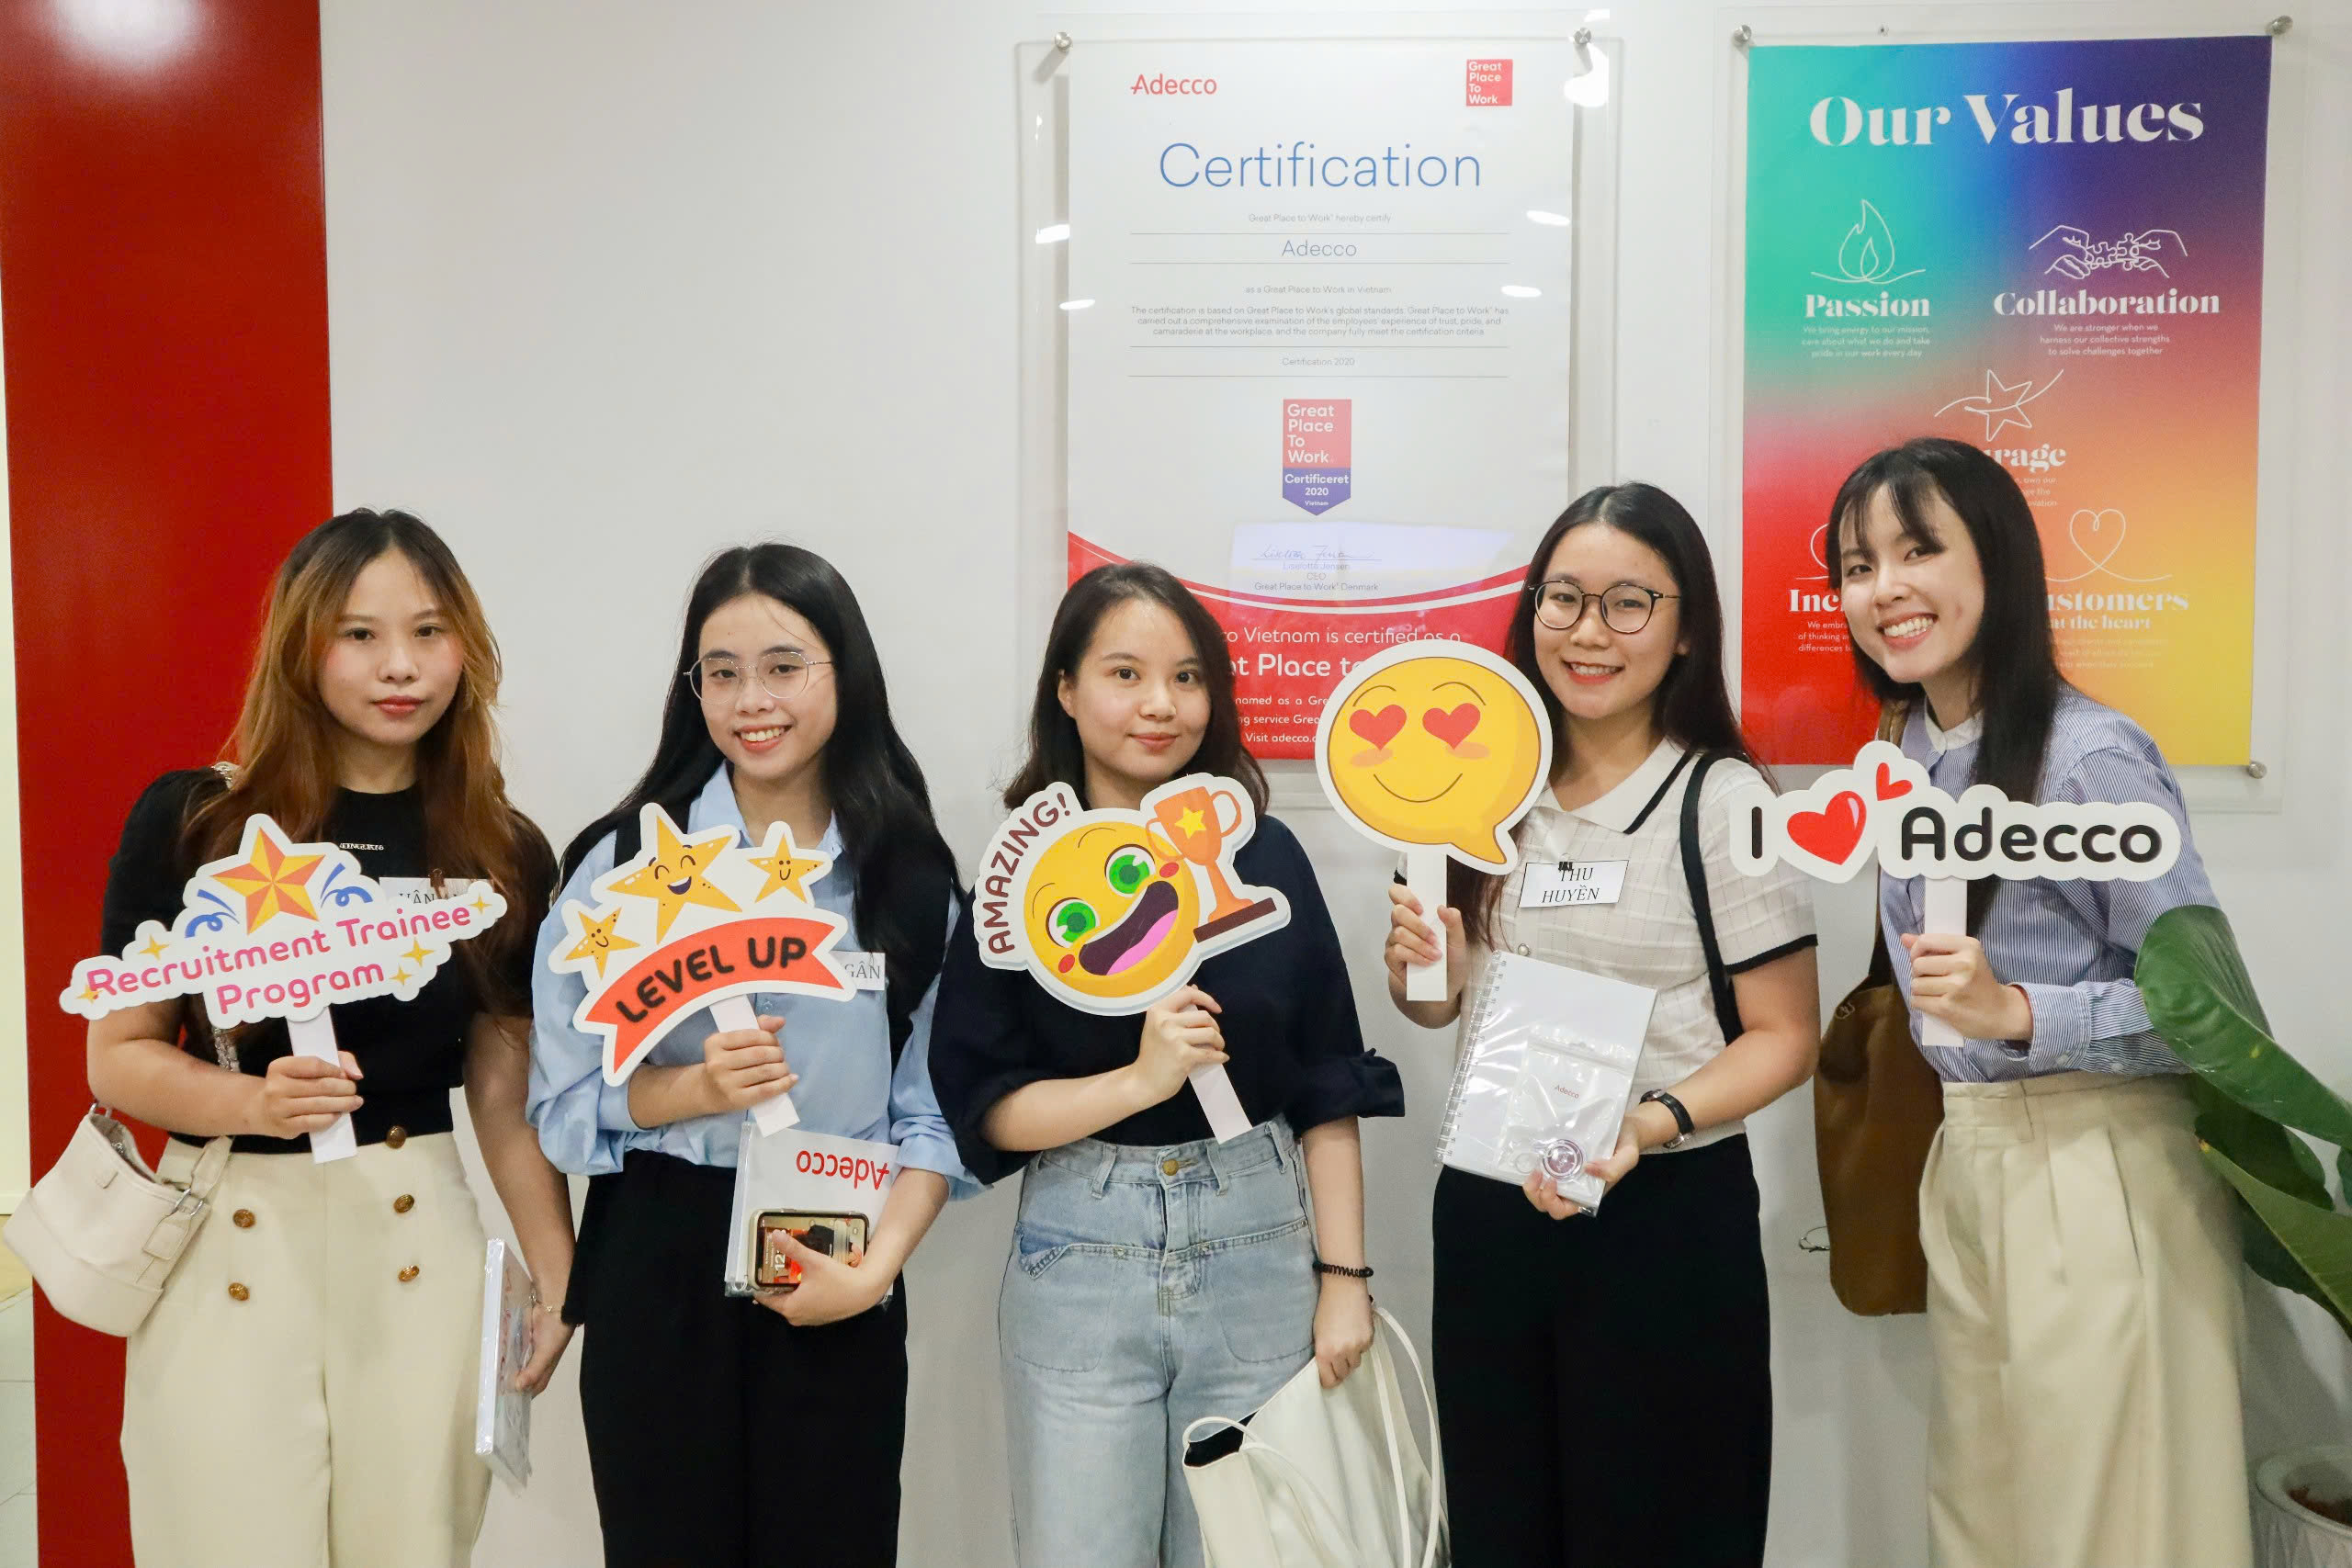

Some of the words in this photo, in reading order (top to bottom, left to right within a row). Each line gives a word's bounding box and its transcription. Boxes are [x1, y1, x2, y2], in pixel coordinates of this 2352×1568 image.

[1469, 61, 1502, 72] Great
[1470, 73, 1501, 81] Place
[1130, 73, 1217, 96] Adecco
[1469, 84, 1481, 92] To
[1469, 94, 1498, 103] Work
[1809, 96, 1951, 147] Our
[1963, 87, 2204, 144] Values
[1159, 141, 1481, 186] Certification
[1249, 213, 1271, 222] Great
[1273, 213, 1295, 222] Place
[1297, 213, 1306, 222] to
[1336, 213, 1363, 223] hereby
[1365, 213, 1391, 223] certify
[1282, 240, 1357, 257] Adecco
[1245, 286, 1254, 294] as
[1264, 286, 1286, 294] Great
[1288, 286, 1310, 294] Place
[1313, 286, 1320, 294] to
[1323, 286, 1345, 294] Work
[1347, 286, 1354, 294] in
[1358, 286, 1391, 294] Vietnam
[1804, 291, 1930, 318] Passion
[1993, 288, 2220, 316] Collaboration
[1336, 307, 1361, 316] global
[2053, 324, 2067, 333] We
[2086, 325, 2119, 333] stronger
[2049, 347, 2056, 355] to
[2060, 347, 2080, 355] solve
[2083, 347, 2126, 356] challenges
[2128, 347, 2163, 356] together
[1287, 404, 1334, 417] Great
[1288, 419, 1334, 432] Place
[1287, 434, 1305, 446] To
[1287, 450, 1329, 463] Work
[1984, 443, 2066, 474] rage
[1284, 474, 1349, 483] Certificeret
[1305, 487, 1329, 496] 2020
[1255, 582, 1277, 591] Great
[1279, 582, 1301, 591] Place
[1304, 582, 1312, 591] to
[1341, 582, 1378, 591] Denmark
[1788, 589, 1845, 612] Inc
[1807, 621, 1821, 629] We
[2070, 615, 2098, 628] the
[2102, 615, 2152, 628] heart
[1244, 627, 1319, 643] Vietnam
[1327, 627, 1338, 643] is
[1344, 627, 1418, 644] certified
[1809, 632, 1840, 642] thinking
[1798, 643, 1843, 652] differences
[1259, 654, 1330, 676] Place
[1235, 696, 1272, 705] named
[1254, 715, 1289, 724] service
[1245, 733, 1268, 742] Visit
[1751, 807, 1762, 860] I
[1902, 807, 2163, 863] Adecco
[982, 793, 1070, 954] AMAZING!
[1542, 885, 1600, 903] HUYỀN
[85, 930, 331, 997] Recruitment
[336, 906, 471, 948] Trainee
[616, 944, 735, 1024] LEVEL
[747, 936, 807, 970] UP
[216, 963, 385, 1015] Program
[1555, 1084, 1580, 1099] Adecco
[796, 1150, 890, 1190] Adecco
